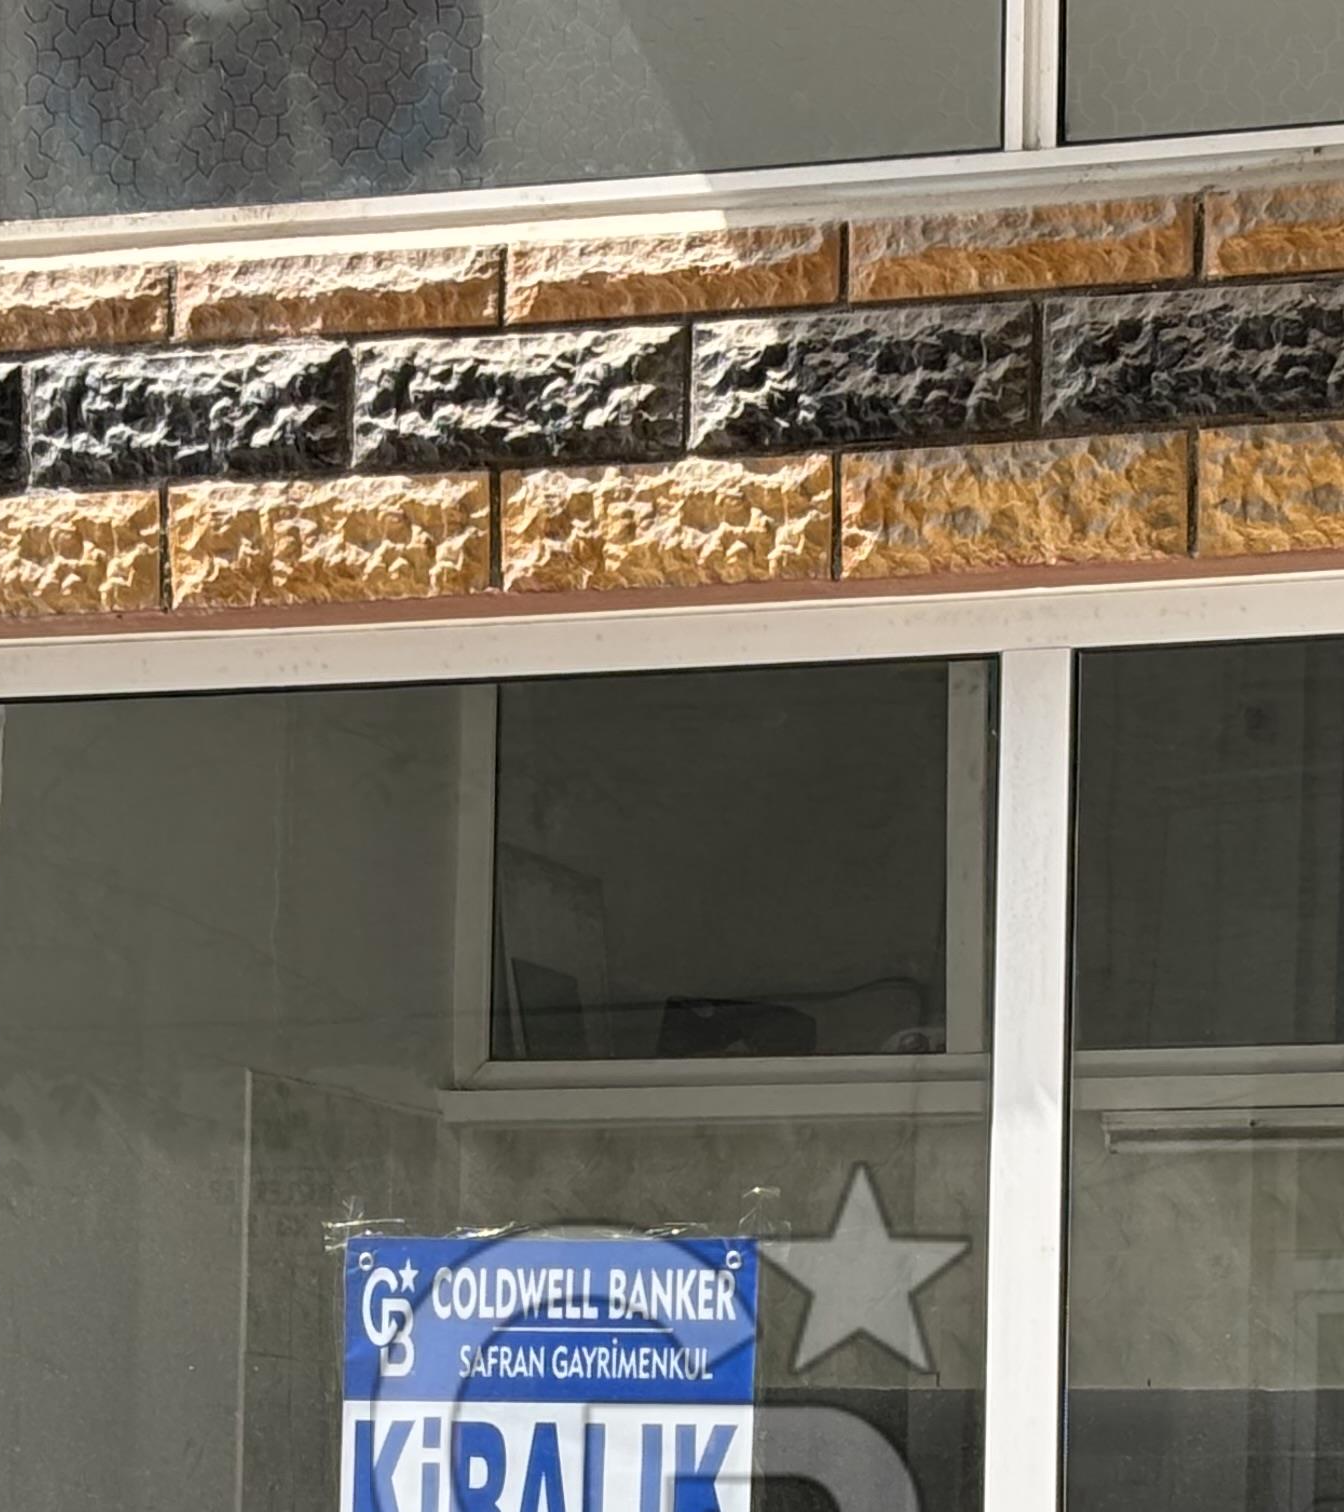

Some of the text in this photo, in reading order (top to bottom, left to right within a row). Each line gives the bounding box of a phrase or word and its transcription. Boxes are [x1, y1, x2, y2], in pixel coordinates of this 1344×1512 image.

[432, 1267, 736, 1321] COLDWELL BANKER
[459, 1337, 713, 1381] SAFRAN GAYRİMENKUL
